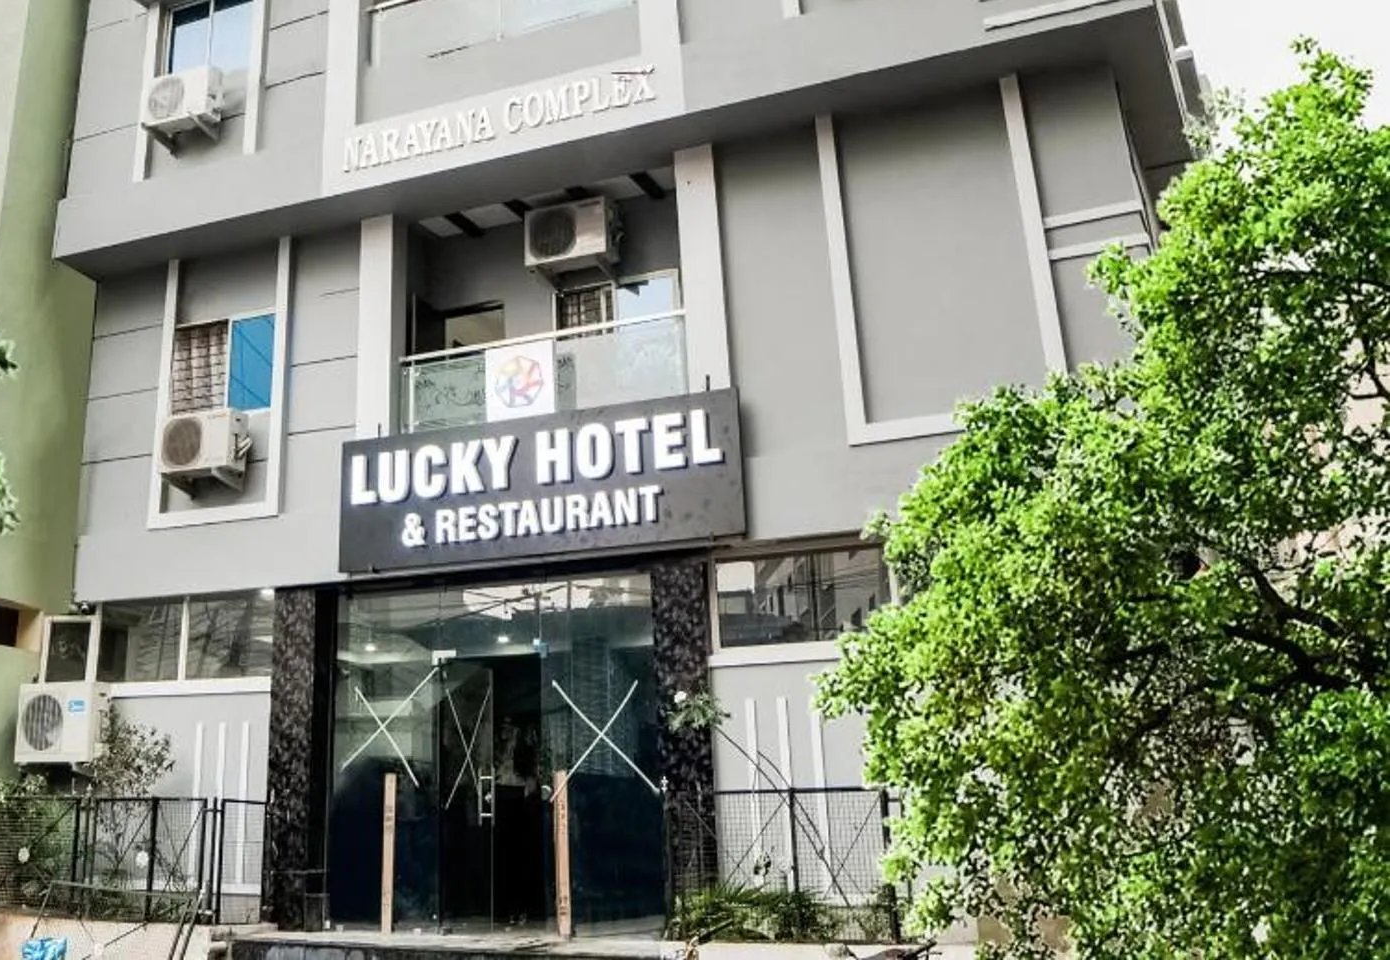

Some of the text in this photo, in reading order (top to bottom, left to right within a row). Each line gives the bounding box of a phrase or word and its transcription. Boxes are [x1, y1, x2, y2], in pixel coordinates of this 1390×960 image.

[342, 67, 657, 171] NARAYANA COMPLEX
[350, 408, 724, 506] LUCKY HOTEL
[401, 485, 664, 548] & RESTAURANT
